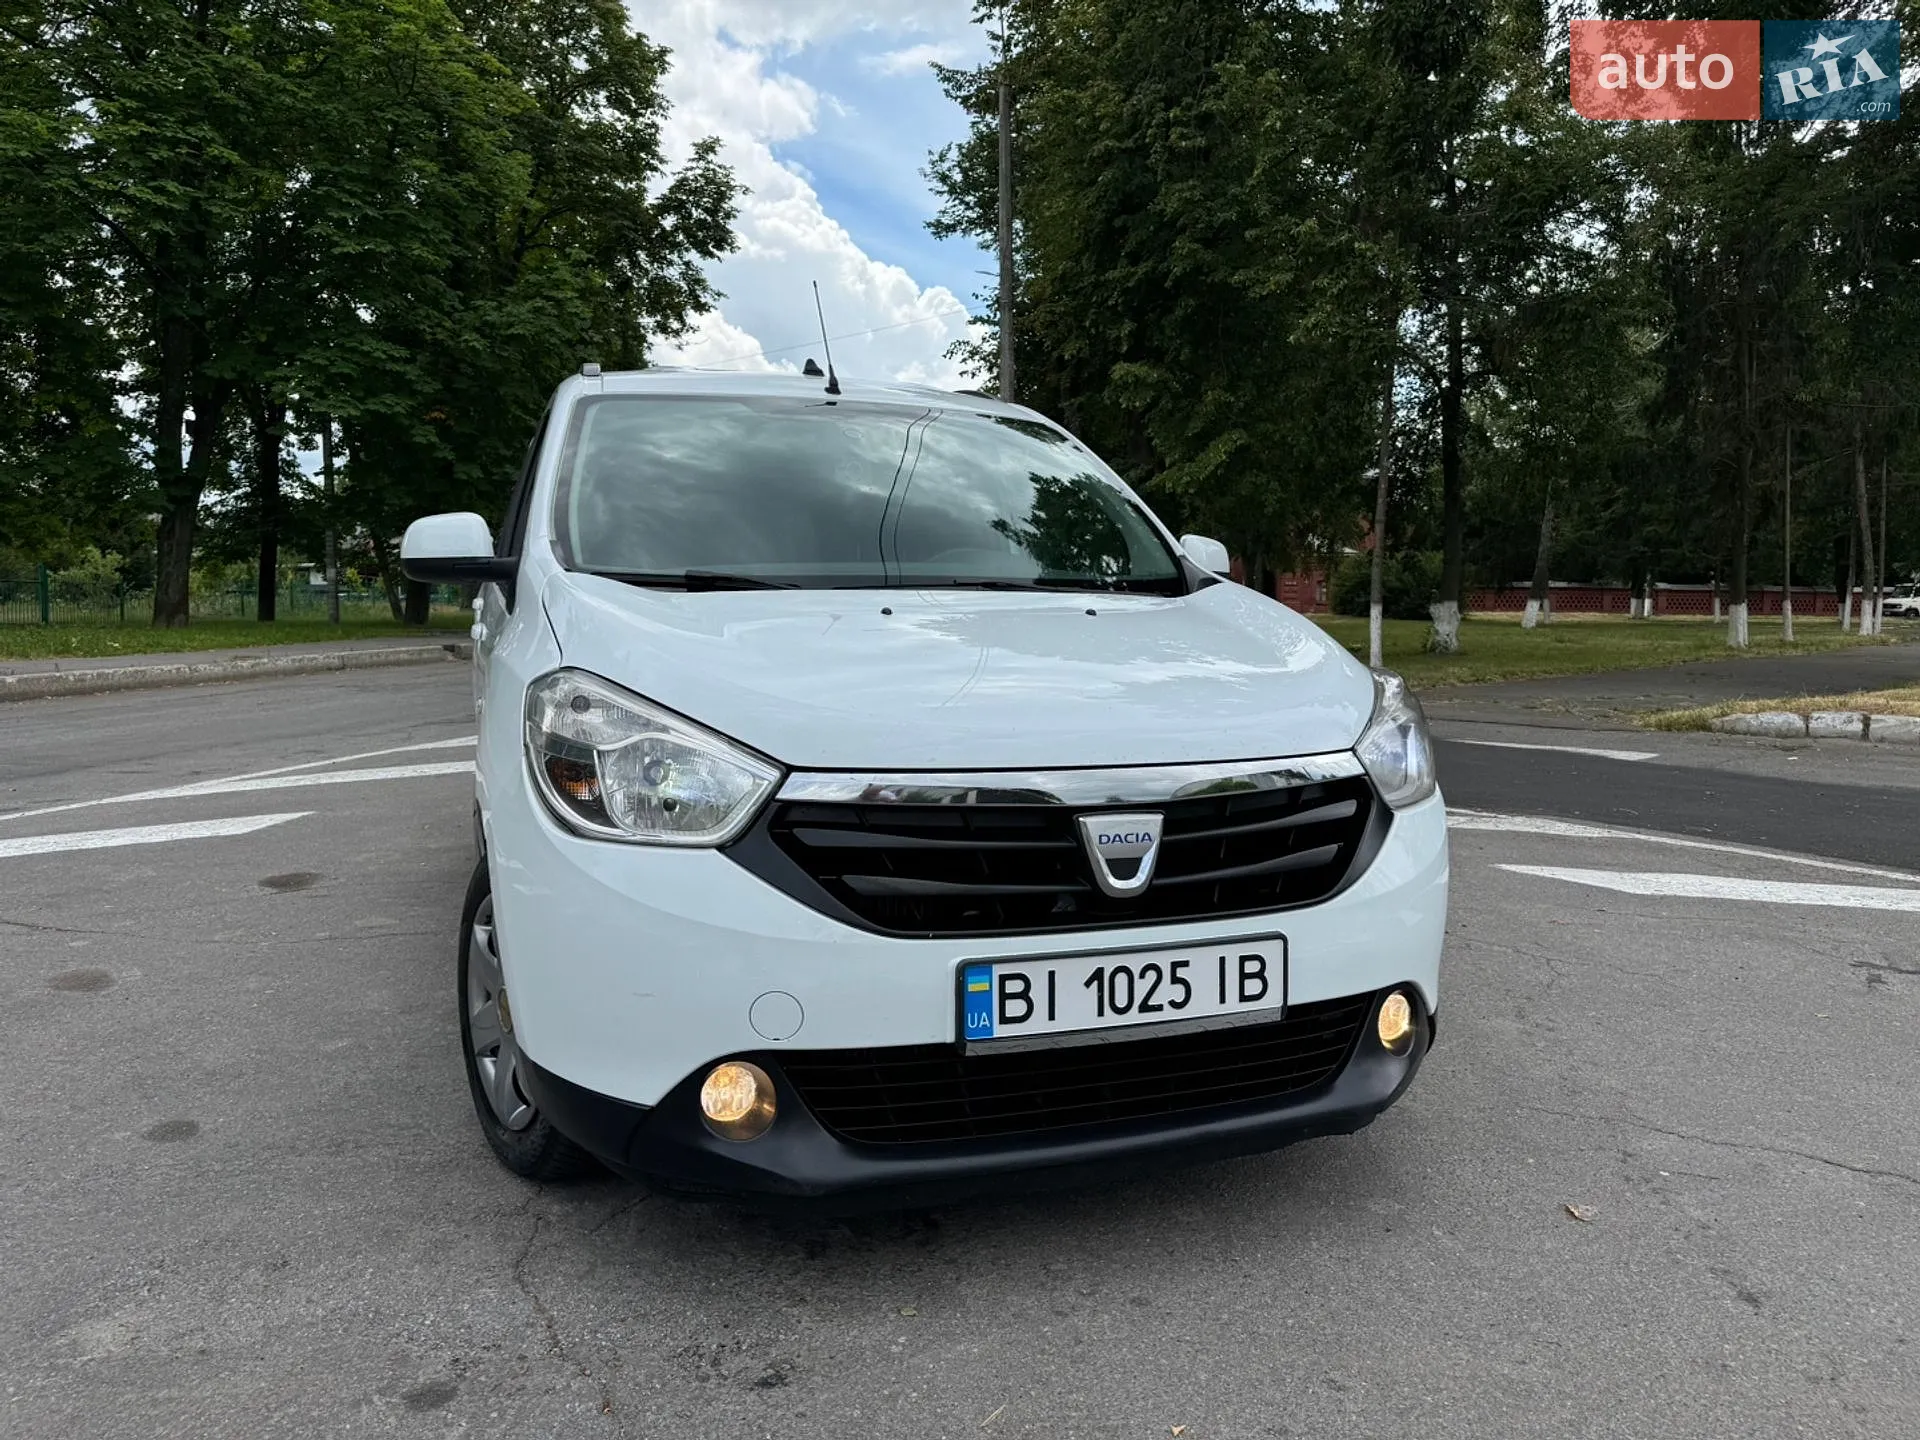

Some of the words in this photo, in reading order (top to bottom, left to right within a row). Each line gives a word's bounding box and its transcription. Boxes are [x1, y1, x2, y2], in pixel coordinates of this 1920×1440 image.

[1098, 832, 1153, 845] DACIA
[998, 969, 1056, 1025] BI
[1083, 960, 1192, 1017] 1025
[1218, 953, 1269, 1004] IB
[967, 1011, 990, 1029] UA
